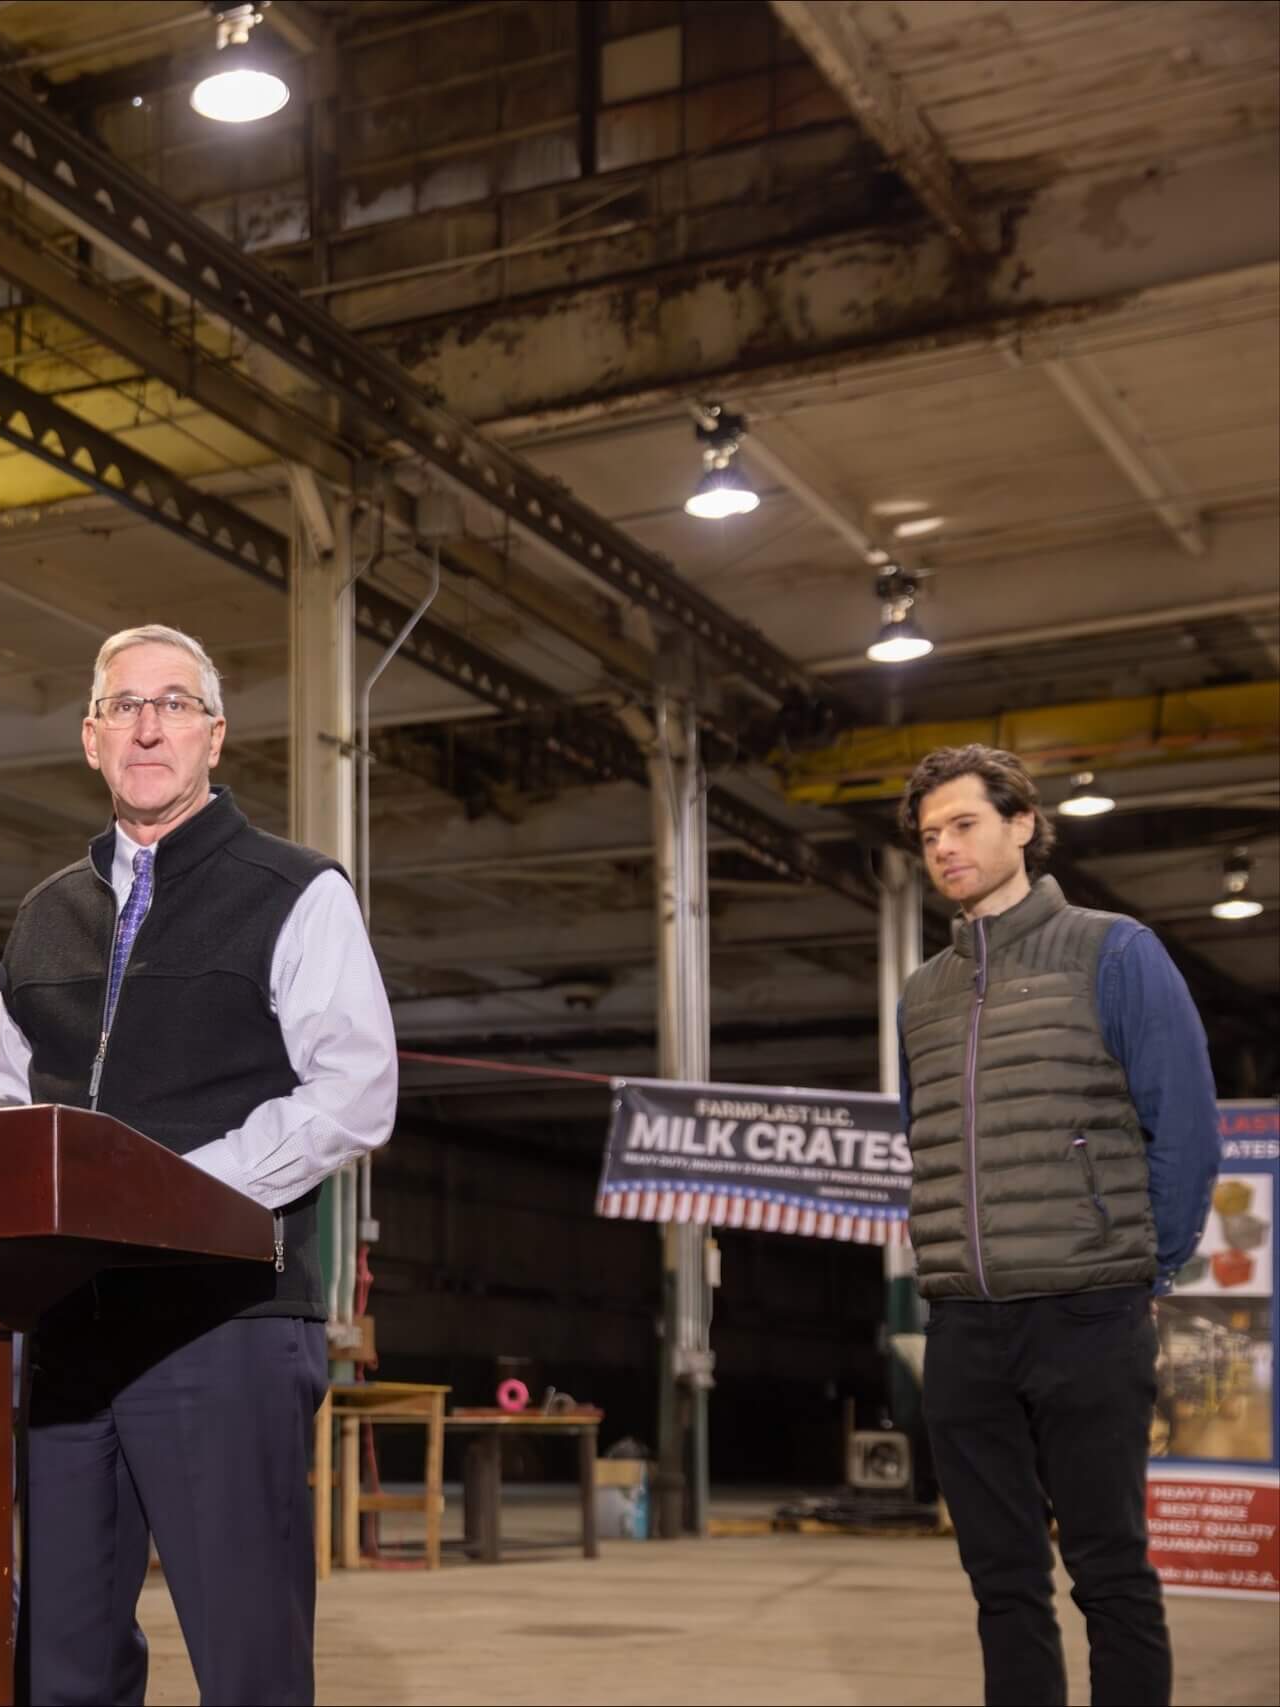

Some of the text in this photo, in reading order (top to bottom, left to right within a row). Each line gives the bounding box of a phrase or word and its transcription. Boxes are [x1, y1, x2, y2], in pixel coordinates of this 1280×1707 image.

[696, 1099, 809, 1124] FARMPLAST
[629, 1112, 912, 1172] MILK CRATES
[1151, 1485, 1256, 1505] HEAVY DUTY
[1157, 1501, 1248, 1521] BEST PRICE
[1205, 1521, 1277, 1541] QUALITY
[1149, 1536, 1259, 1556] GUARANTEED
